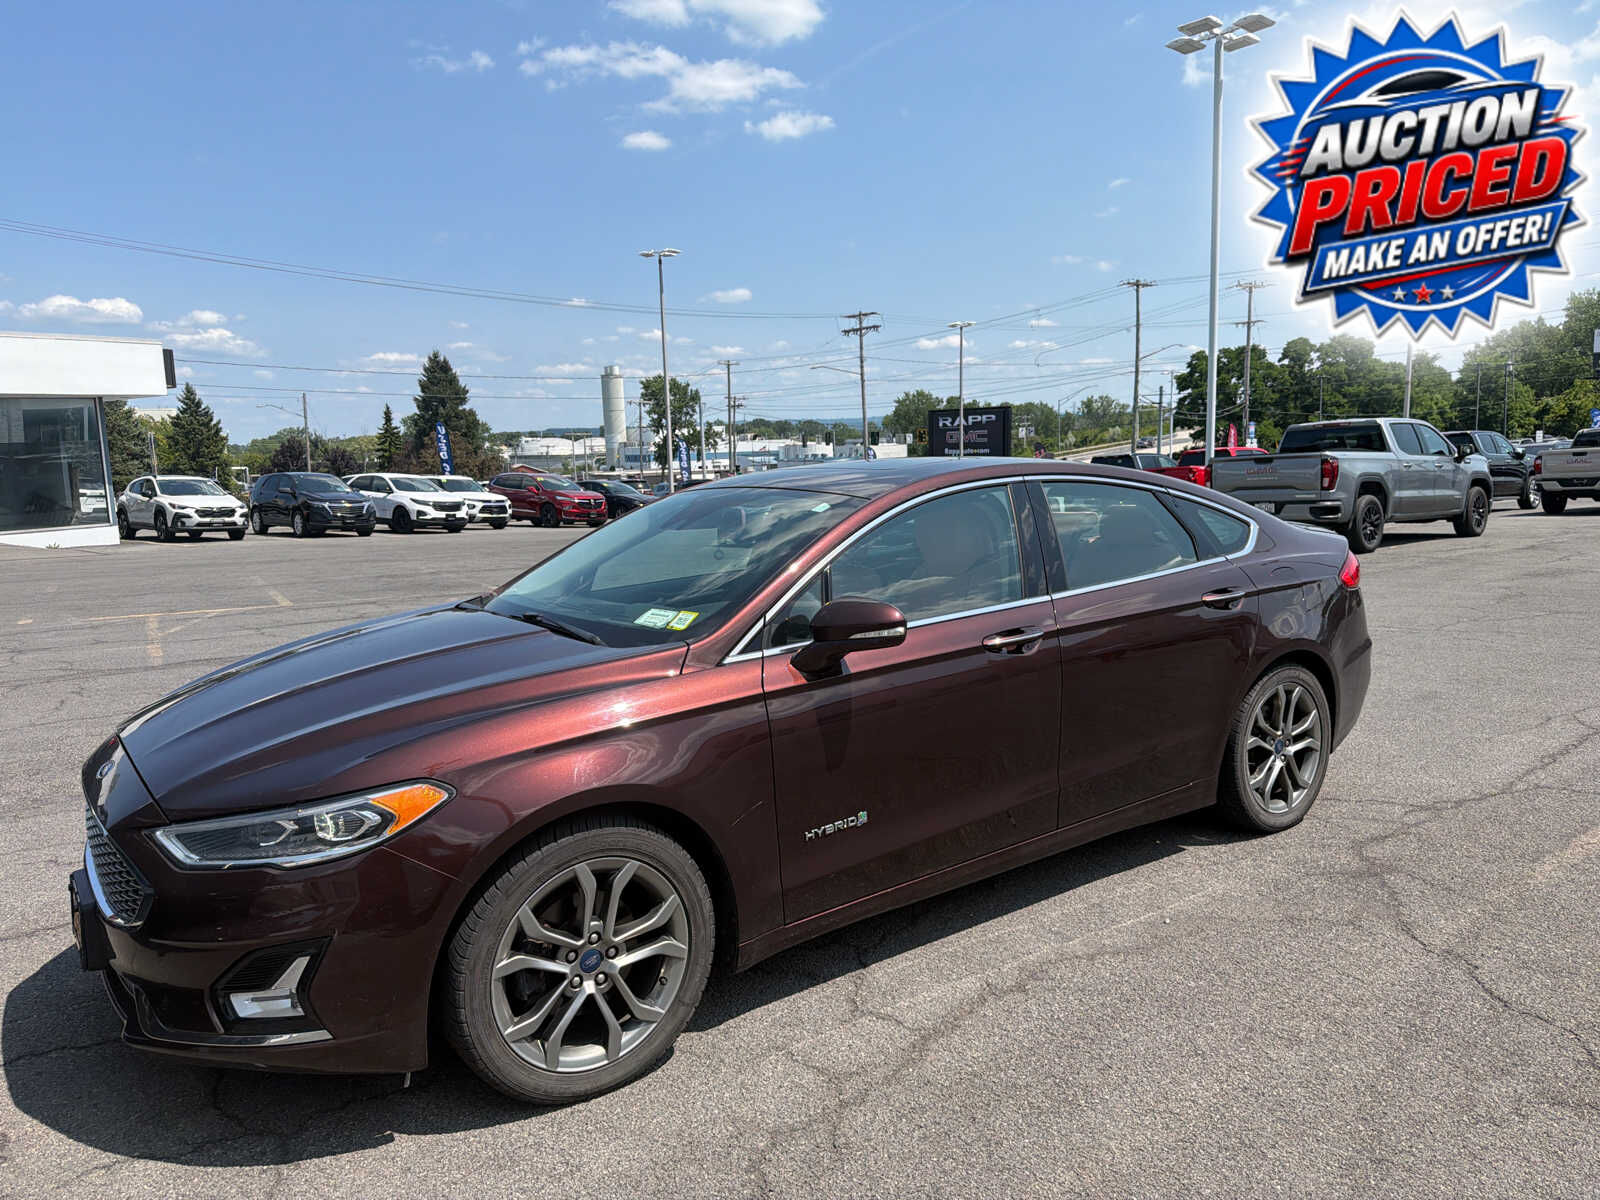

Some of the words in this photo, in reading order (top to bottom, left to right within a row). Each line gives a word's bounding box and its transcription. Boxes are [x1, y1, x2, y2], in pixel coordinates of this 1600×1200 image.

[938, 414, 996, 428] RAPP
[946, 430, 988, 443] GMC
[804, 816, 858, 841] HYBRID
